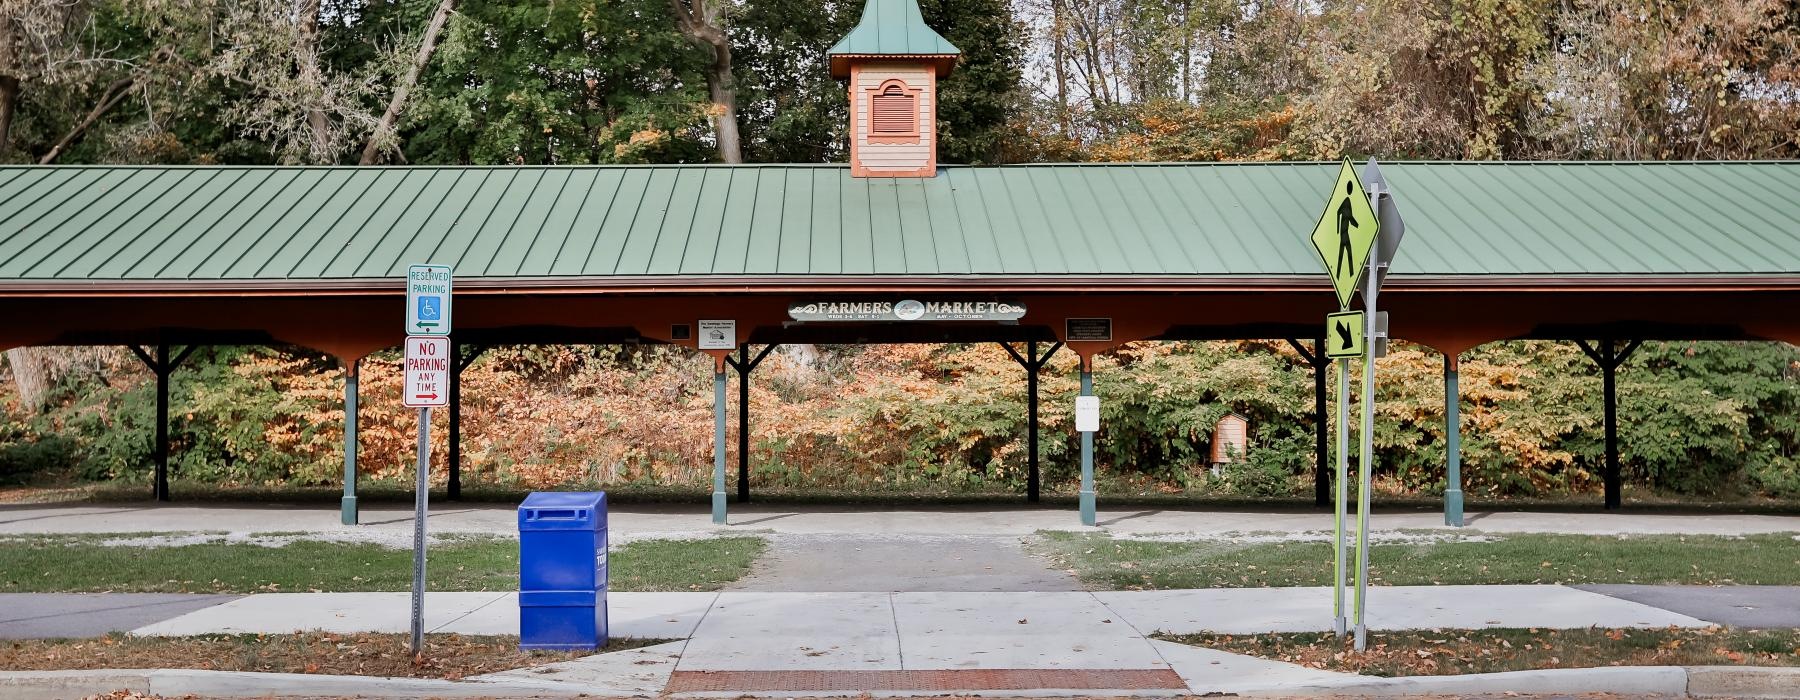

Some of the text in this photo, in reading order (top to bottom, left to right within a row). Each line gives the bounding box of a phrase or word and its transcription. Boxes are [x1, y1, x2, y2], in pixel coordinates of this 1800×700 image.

[411, 272, 449, 281] RESERVED
[413, 284, 446, 293] PARKING
[818, 301, 998, 314] FARMER'S MARKET
[419, 342, 436, 356] NO
[408, 358, 446, 371] PARKING
[418, 373, 436, 382] ANY
[416, 382, 437, 392] TIME
